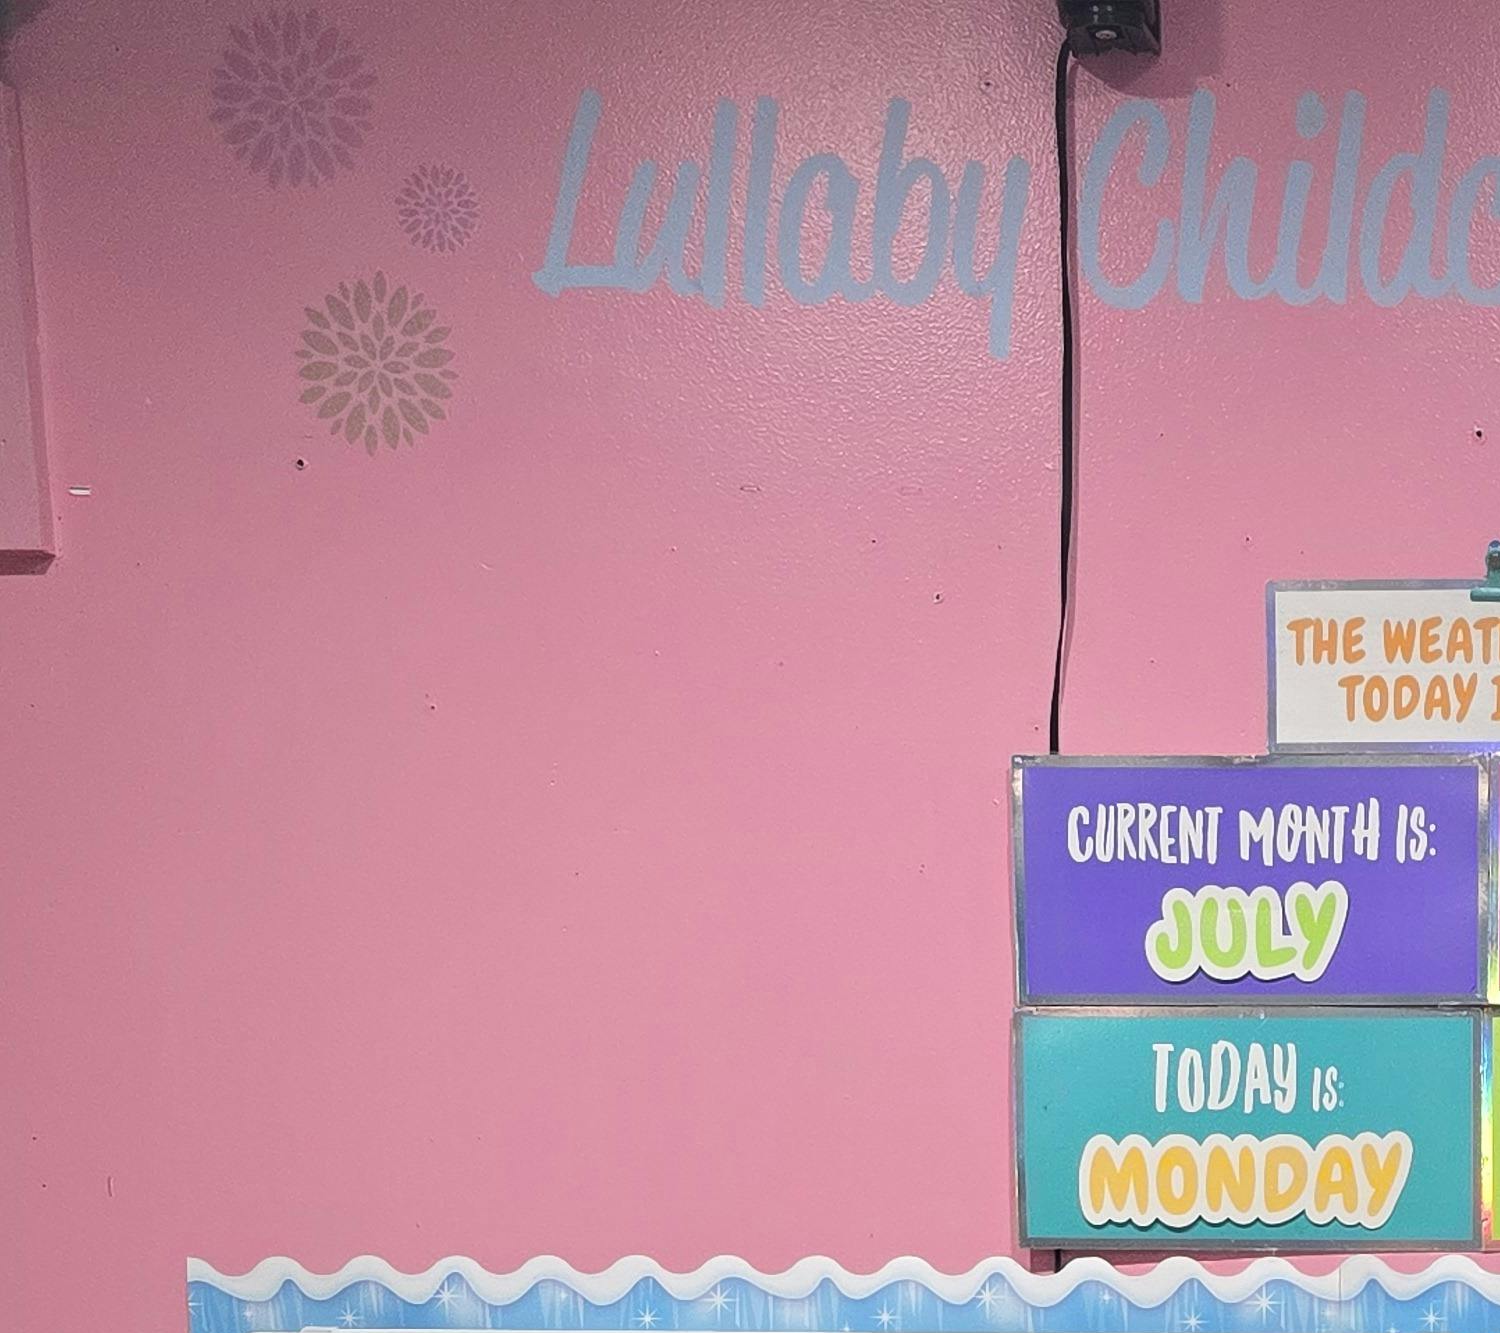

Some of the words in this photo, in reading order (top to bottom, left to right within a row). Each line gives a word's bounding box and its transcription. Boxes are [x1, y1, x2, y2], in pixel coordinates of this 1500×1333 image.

[532, 87, 1032, 360] Lullaby
[1286, 618, 1367, 665] THE
[1337, 673, 1477, 723] TODAY
[1066, 803, 1223, 864] CURRENT
[1238, 797, 1381, 867] MONTH
[1395, 802, 1438, 861] IS:
[1152, 890, 1342, 975] JULY
[1151, 1040, 1297, 1115] TODAY
[1310, 1069, 1346, 1112] IS:
[1087, 1140, 1404, 1217] MONDAY
